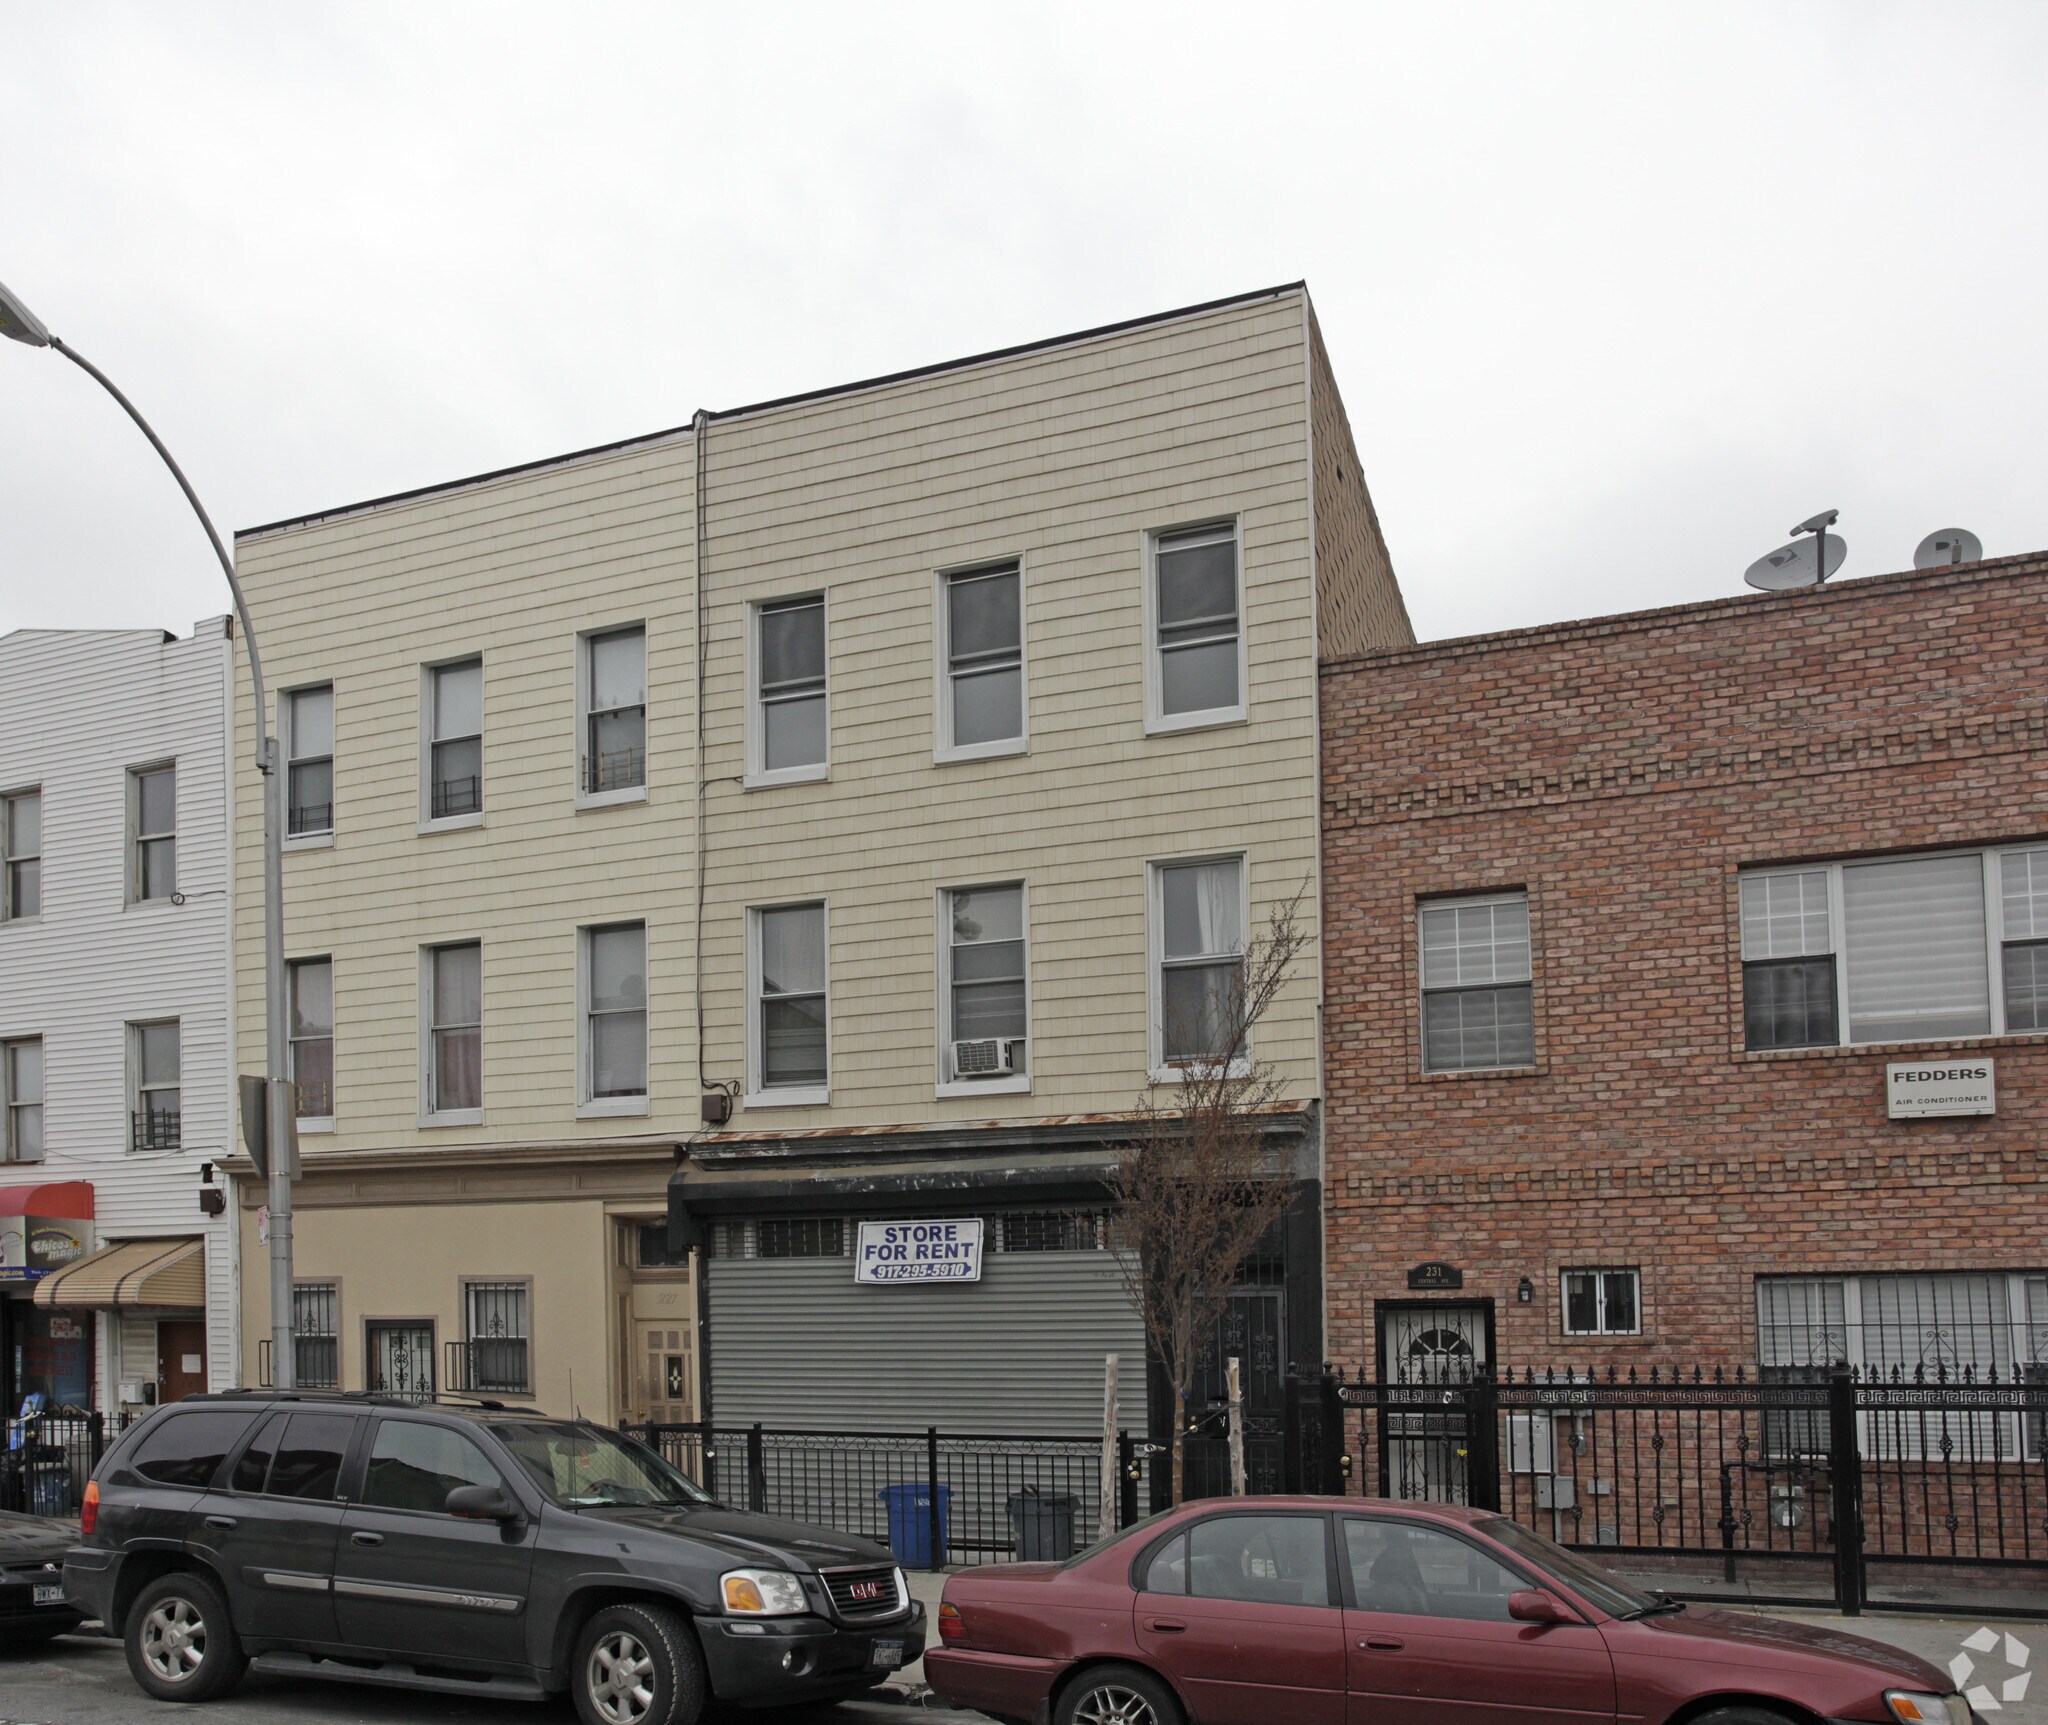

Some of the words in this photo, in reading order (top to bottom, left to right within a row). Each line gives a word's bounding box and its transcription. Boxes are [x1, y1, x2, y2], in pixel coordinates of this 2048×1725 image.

[1893, 1067, 1987, 1083] FEDDERS
[1895, 1098, 1913, 1106] AIR
[1917, 1095, 1988, 1105] CONDITIONER
[884, 1225, 957, 1244] STORE
[864, 1244, 908, 1261] FOR
[915, 1242, 974, 1260] RENT
[877, 1263, 965, 1279] 917-295-5910
[1426, 1266, 1442, 1277] 231
[657, 1292, 679, 1305] 227
[849, 1581, 886, 1600] GMC
